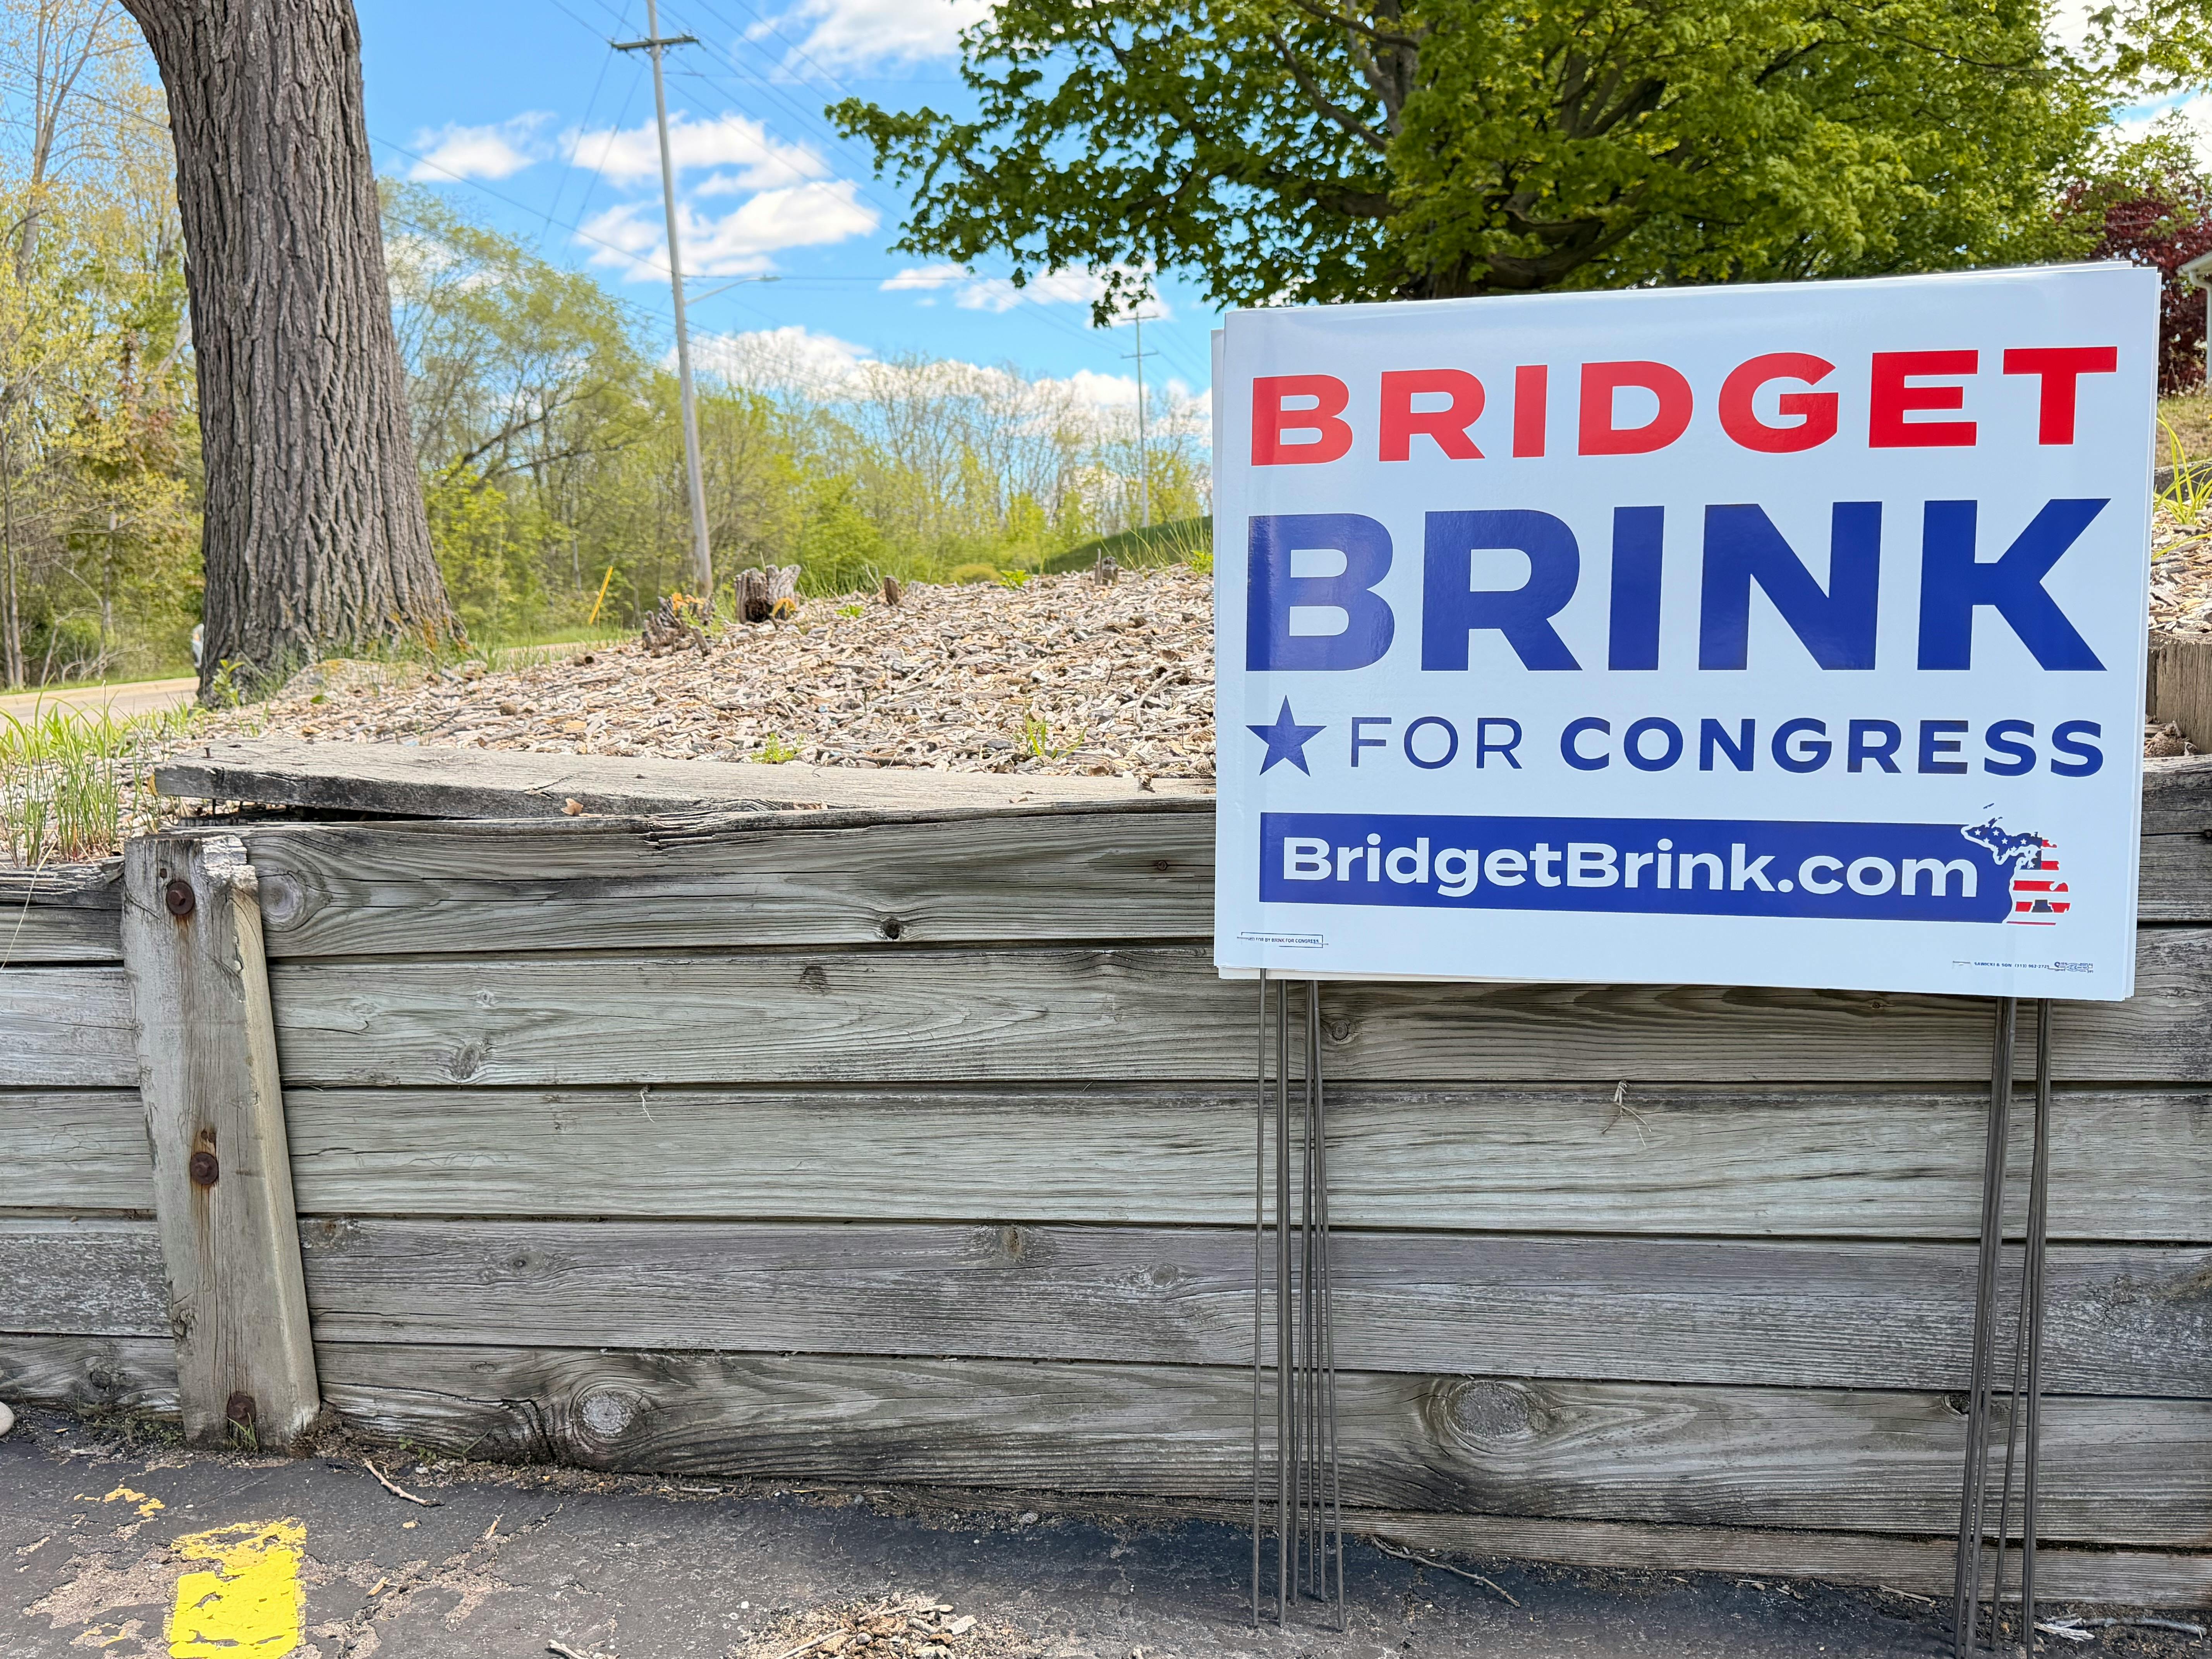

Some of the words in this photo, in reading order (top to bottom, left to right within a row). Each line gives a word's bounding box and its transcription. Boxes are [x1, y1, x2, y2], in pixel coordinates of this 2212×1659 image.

[1251, 347, 2118, 466] BRIDGET
[1245, 498, 2111, 672] BRINK
[1351, 716, 1522, 769] FOR
[1560, 717, 2104, 778] CONGRESS
[1283, 833, 1978, 898] BridgetBrink.com
